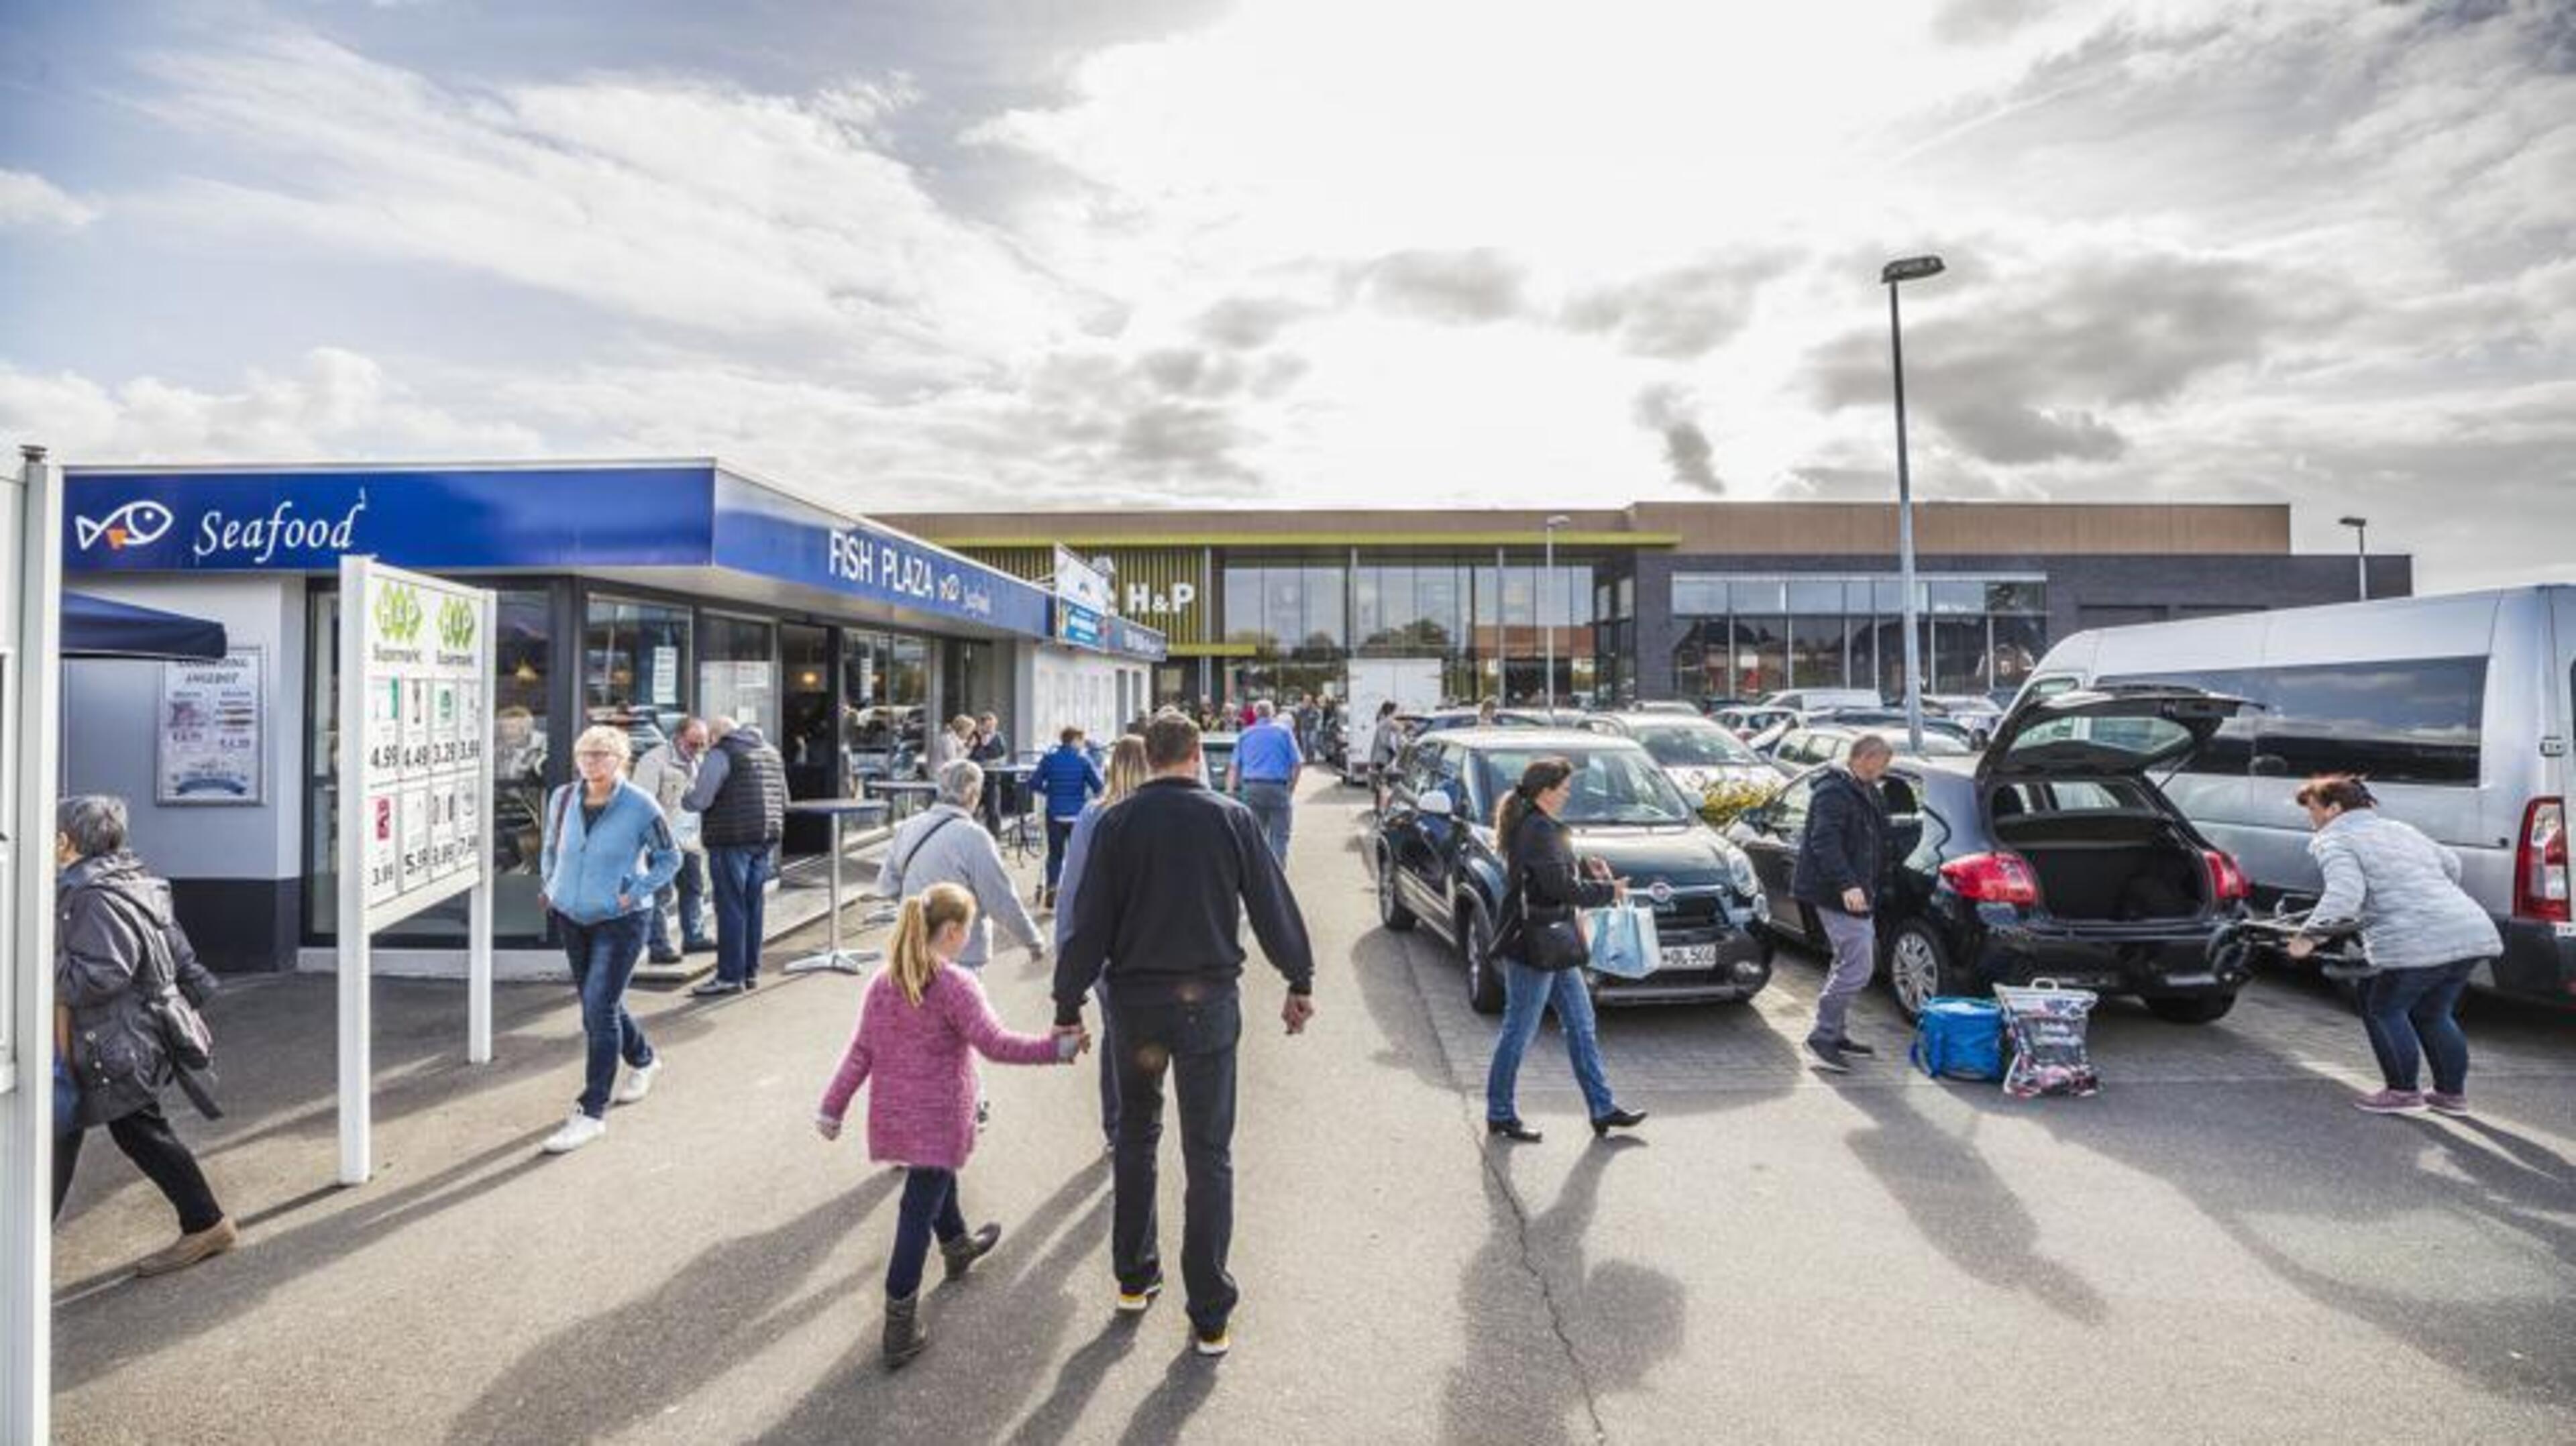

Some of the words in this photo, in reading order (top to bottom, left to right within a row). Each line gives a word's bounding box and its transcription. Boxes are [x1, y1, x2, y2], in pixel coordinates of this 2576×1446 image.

[194, 488, 366, 565] Seafood
[829, 529, 872, 583] FISH
[882, 548, 933, 600] PLAZA
[371, 744, 398, 769] 4.99
[404, 745, 428, 767] 4.49
